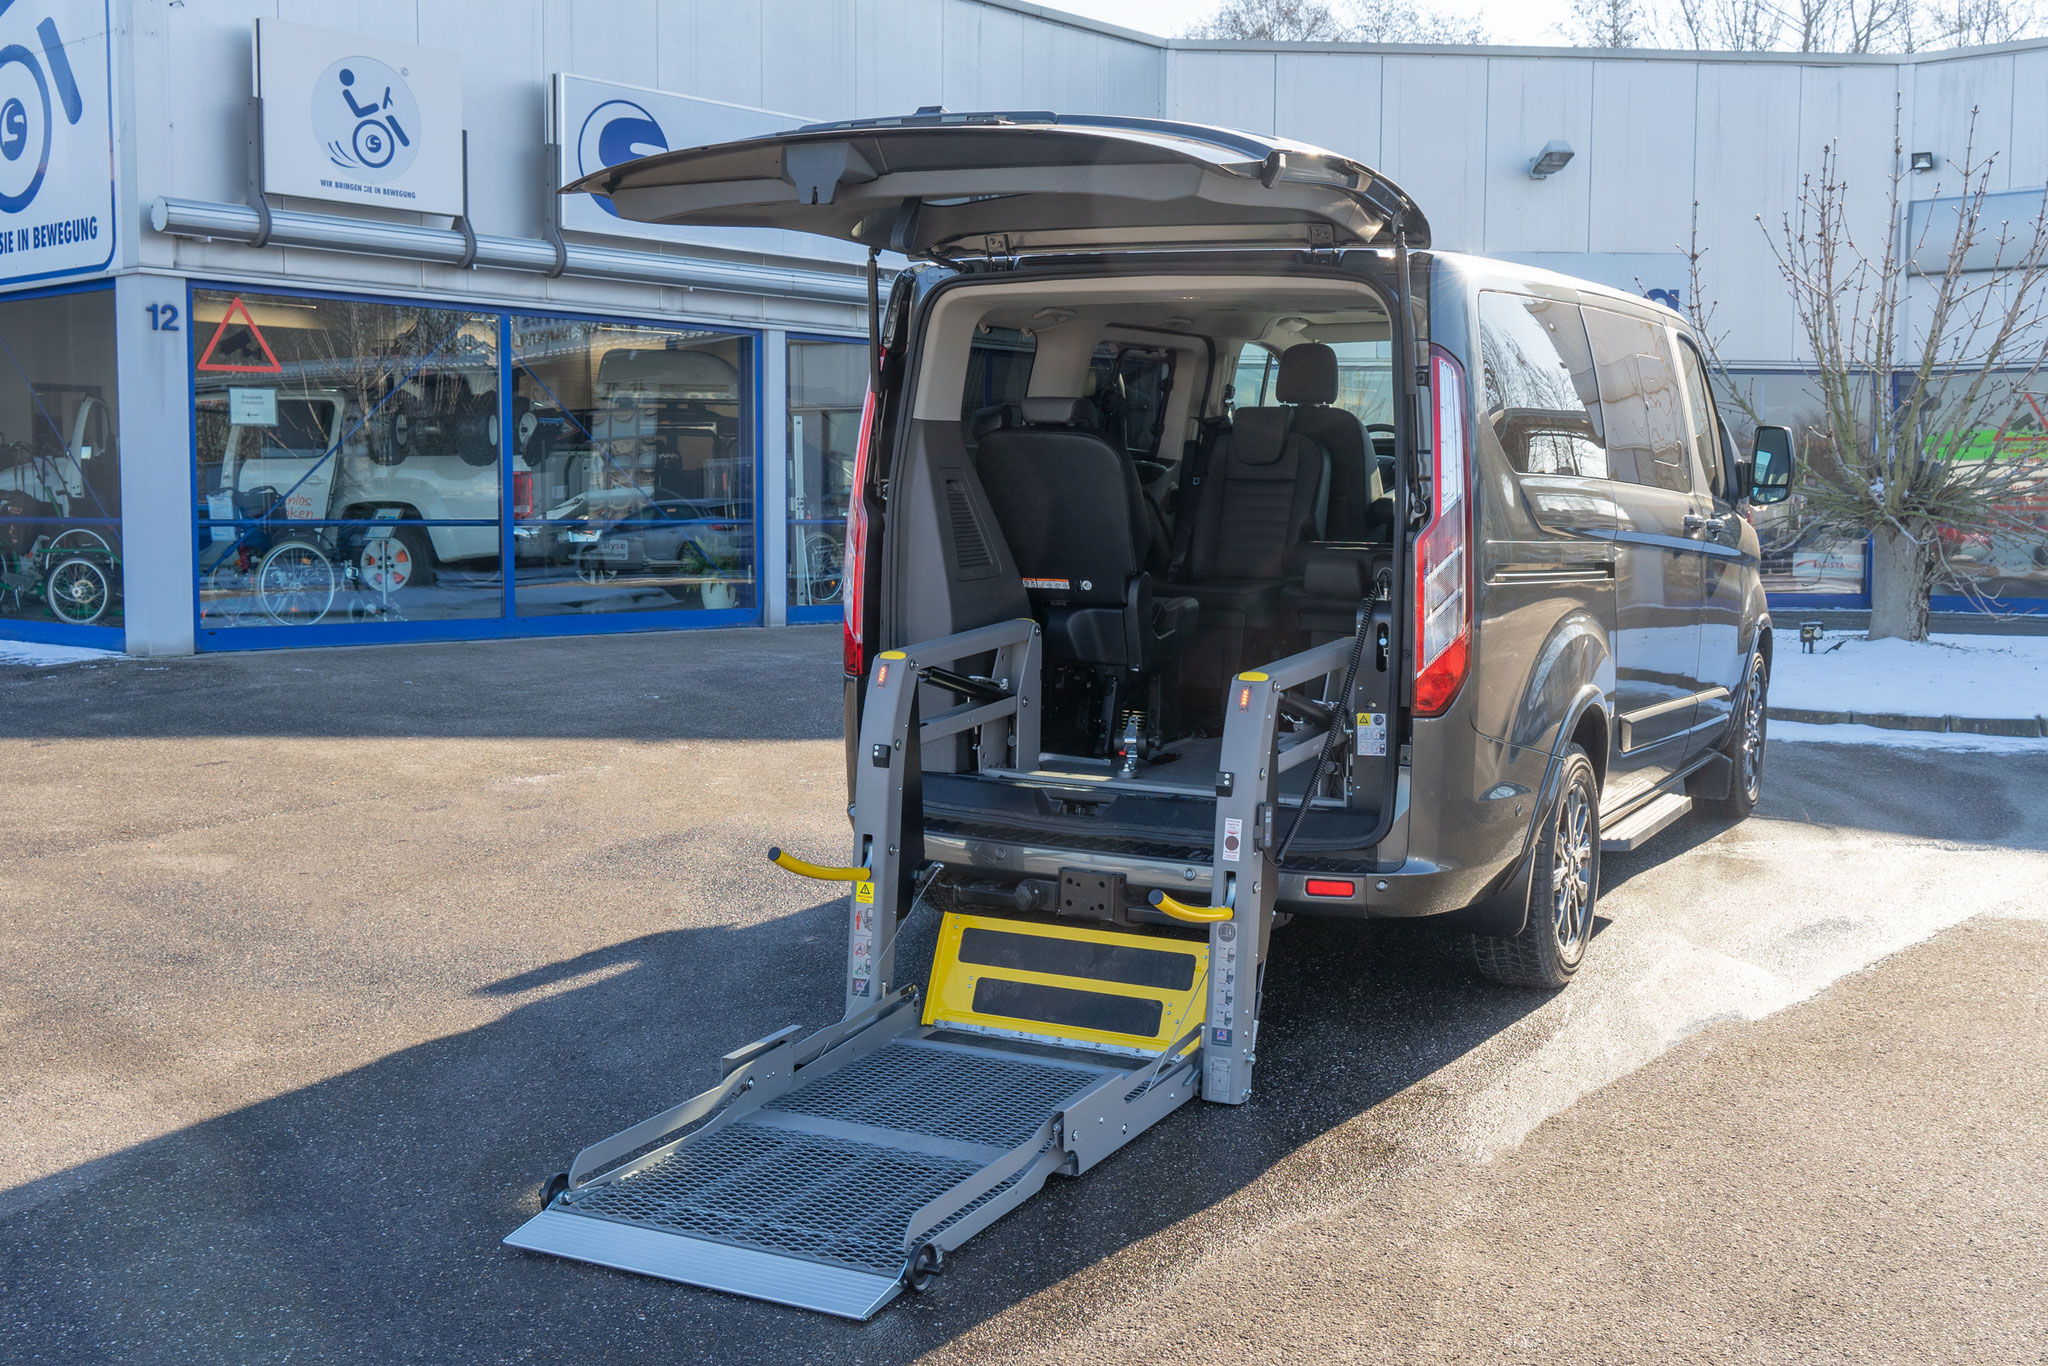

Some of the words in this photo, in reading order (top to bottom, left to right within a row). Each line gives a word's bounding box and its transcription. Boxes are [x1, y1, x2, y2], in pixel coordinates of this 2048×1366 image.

[320, 179, 333, 188] WIR
[334, 181, 362, 192] BRINGEN
[374, 187, 381, 195] IN
[382, 188, 416, 199] BEWEGUNG
[17, 228, 29, 252] IN
[33, 215, 98, 249] BEWEGUNG
[145, 303, 180, 331] 12
